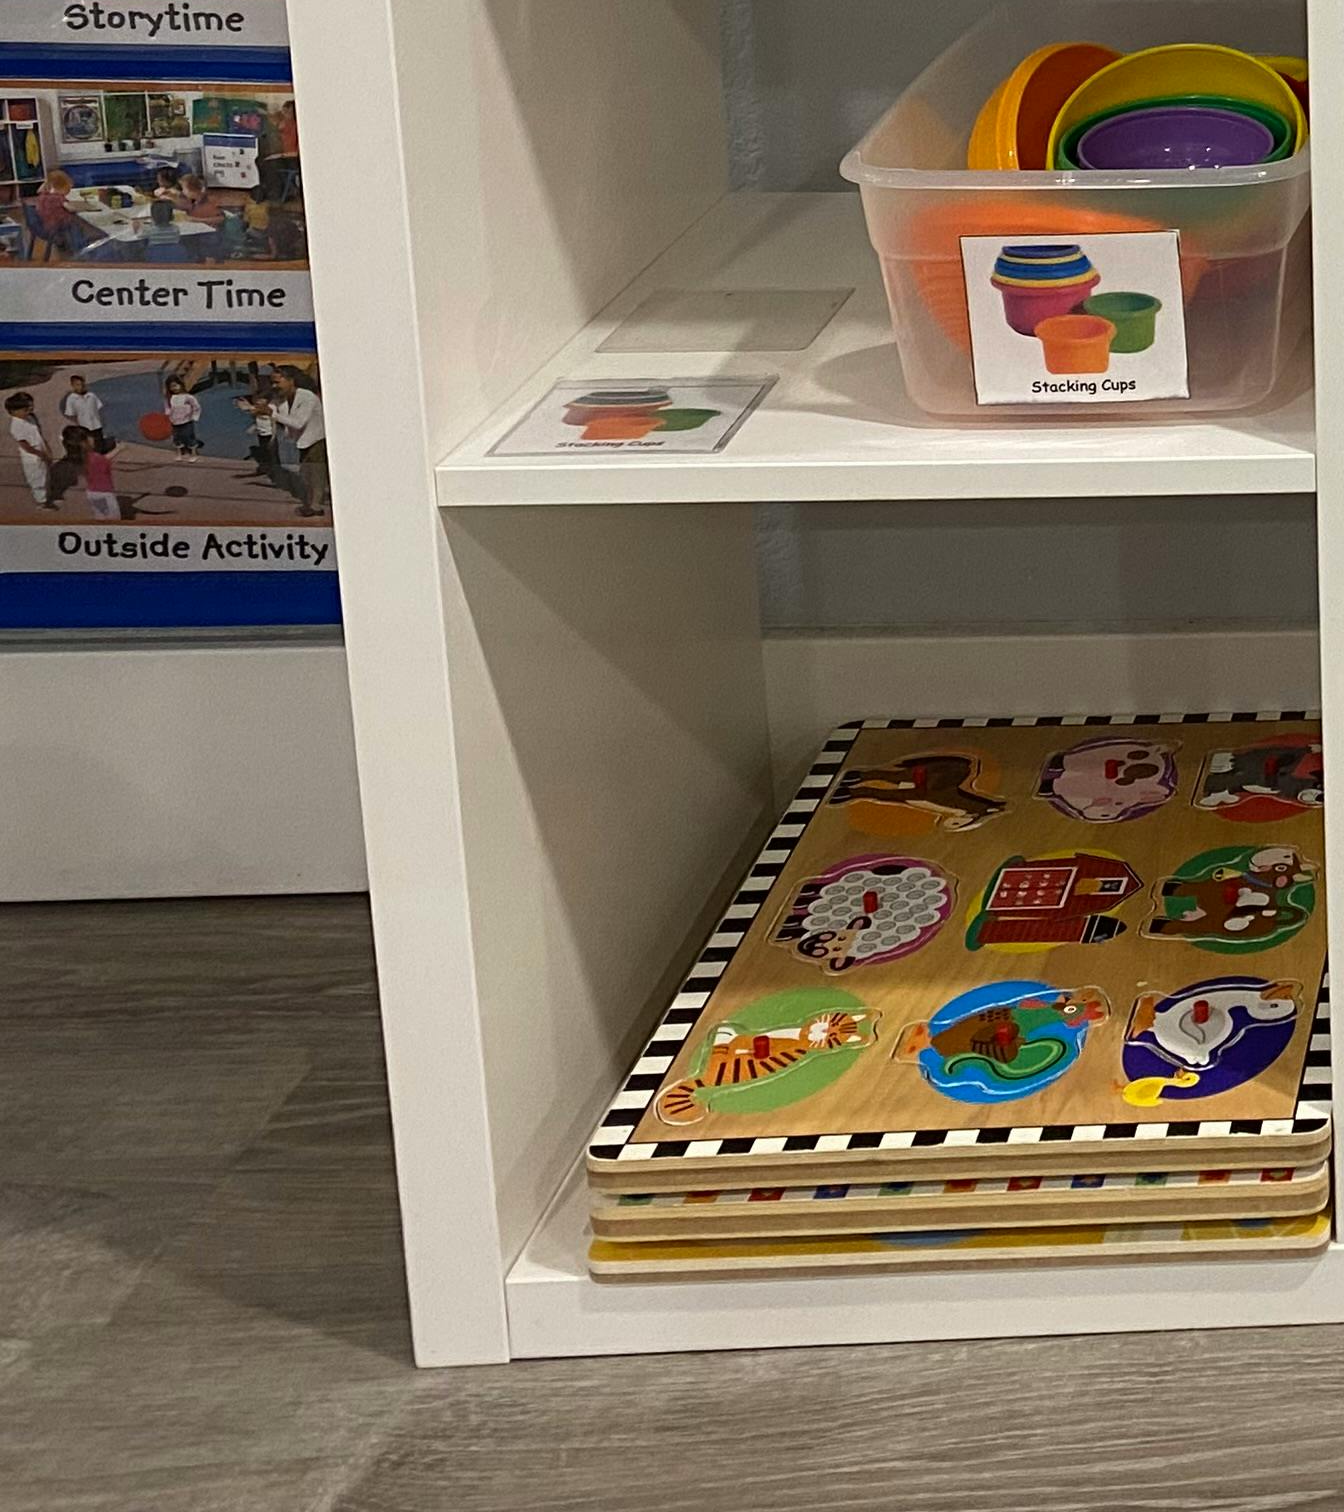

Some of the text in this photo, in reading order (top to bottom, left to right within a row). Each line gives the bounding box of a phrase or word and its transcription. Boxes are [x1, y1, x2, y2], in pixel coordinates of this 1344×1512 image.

[63, 1, 246, 39] Storytime
[71, 279, 287, 309] Center Time
[1031, 379, 1136, 395] Stacking Cups
[57, 533, 330, 567] Outside Activity
